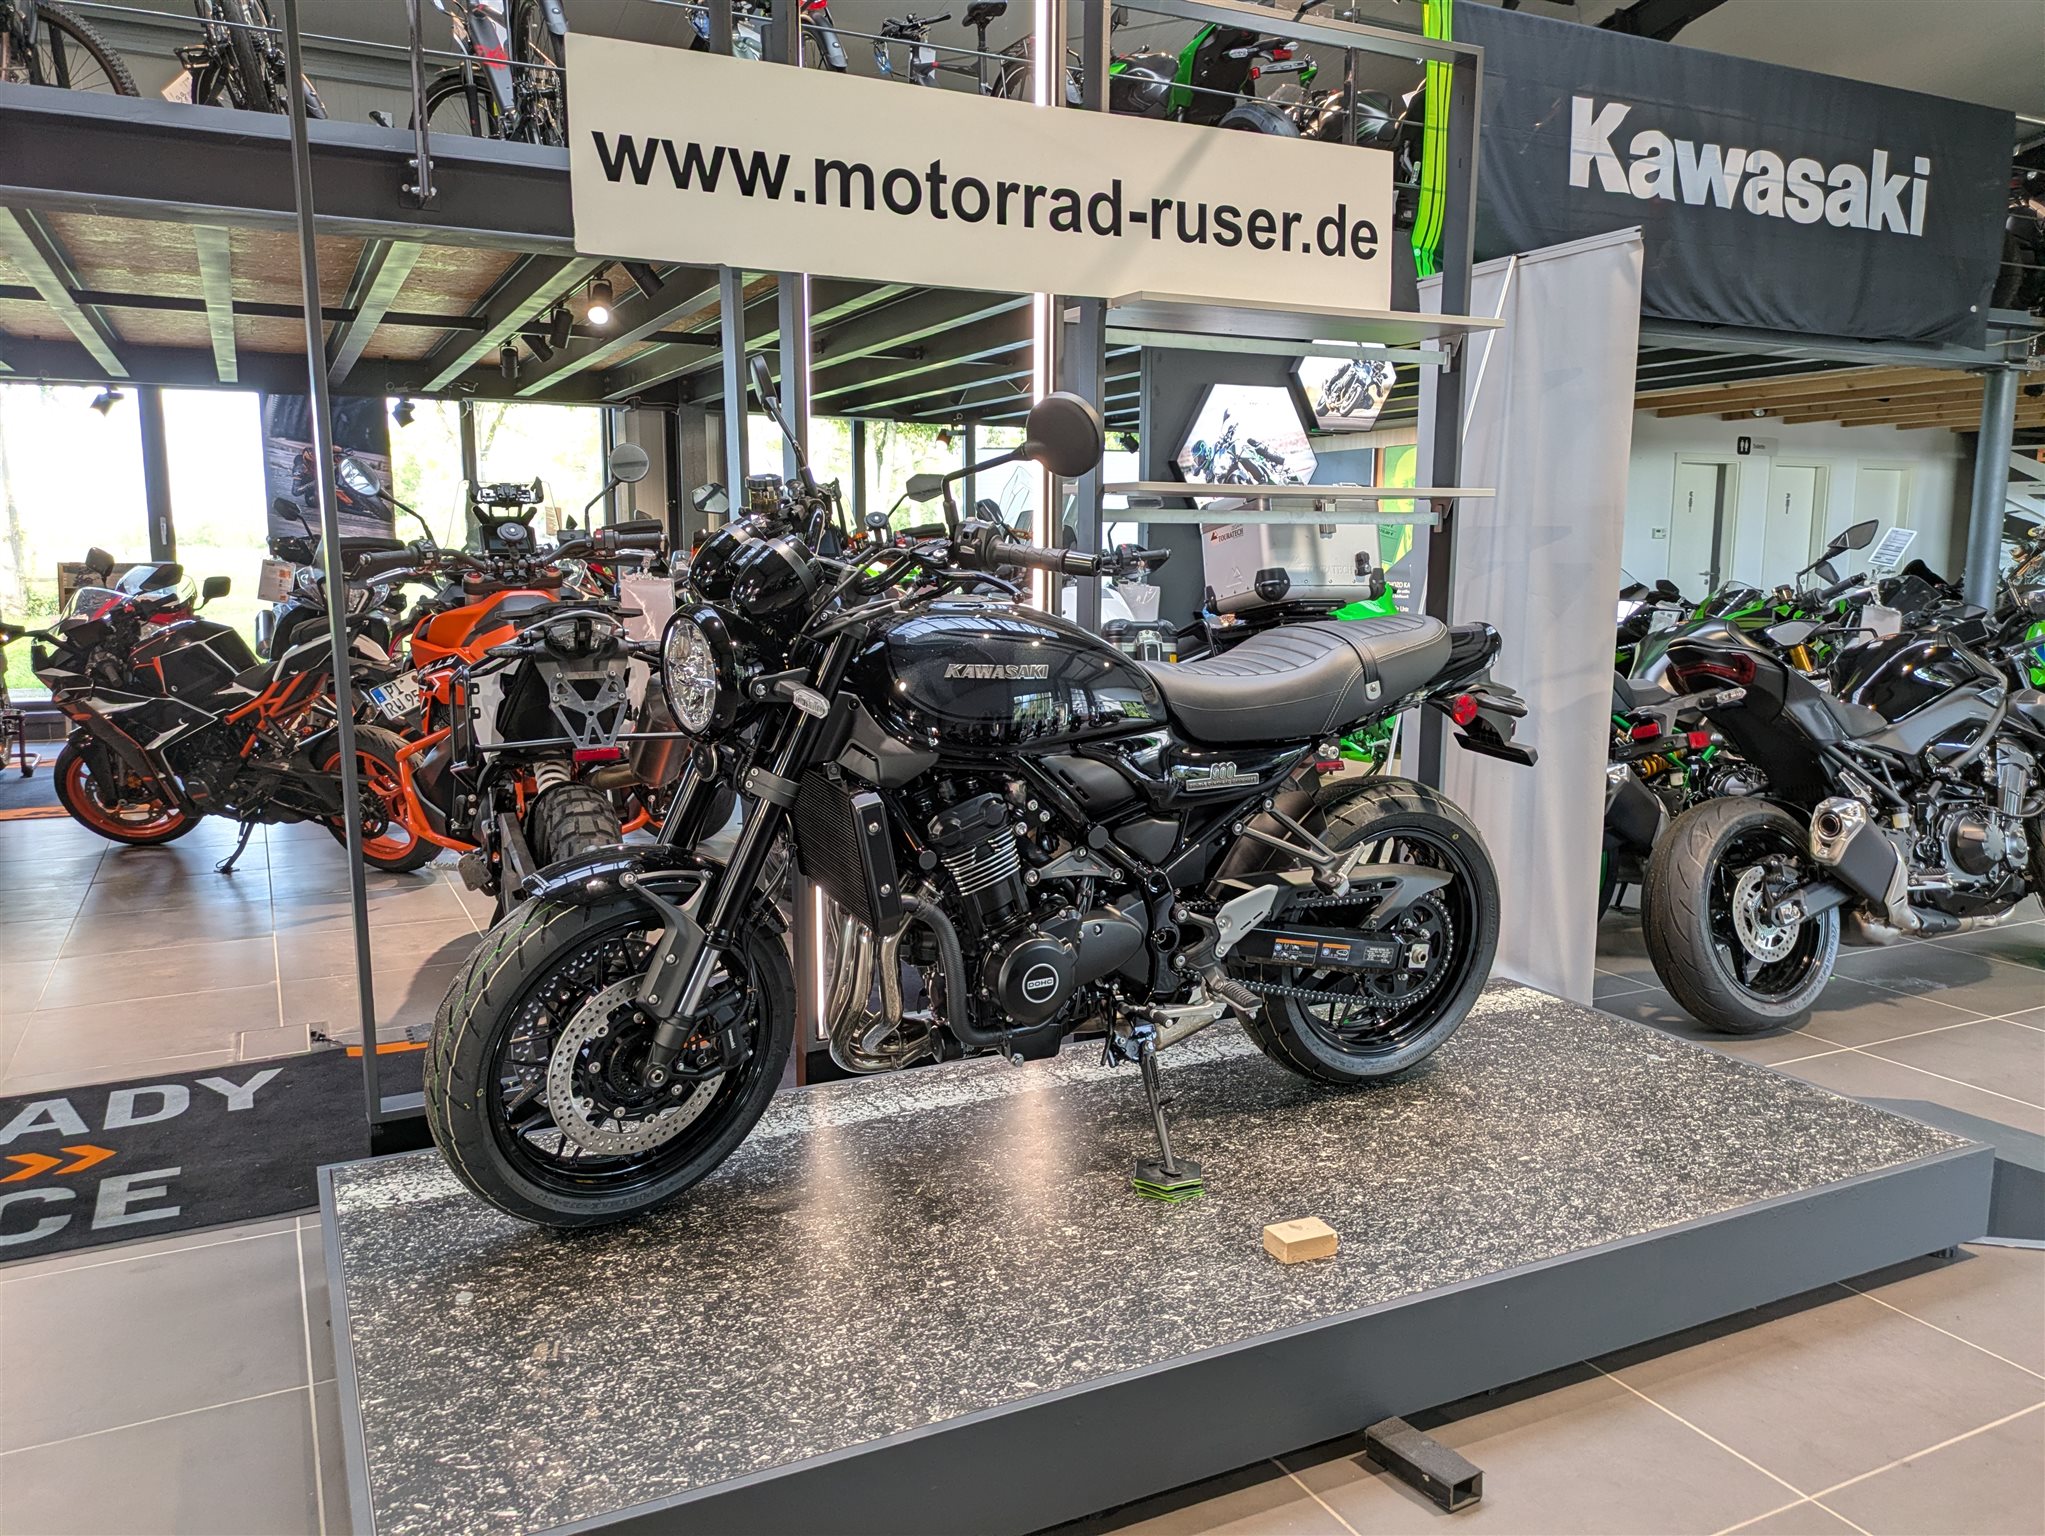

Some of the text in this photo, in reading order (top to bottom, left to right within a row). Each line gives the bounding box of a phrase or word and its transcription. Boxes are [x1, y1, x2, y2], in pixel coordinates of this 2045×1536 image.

[1569, 96, 1931, 236] Kawasaki
[591, 130, 1378, 260] www.motorrad-ruser.de
[944, 663, 1049, 679] KAWASAKI
[384, 682, 404, 699] PI
[1028, 978, 1053, 988] DOHC
